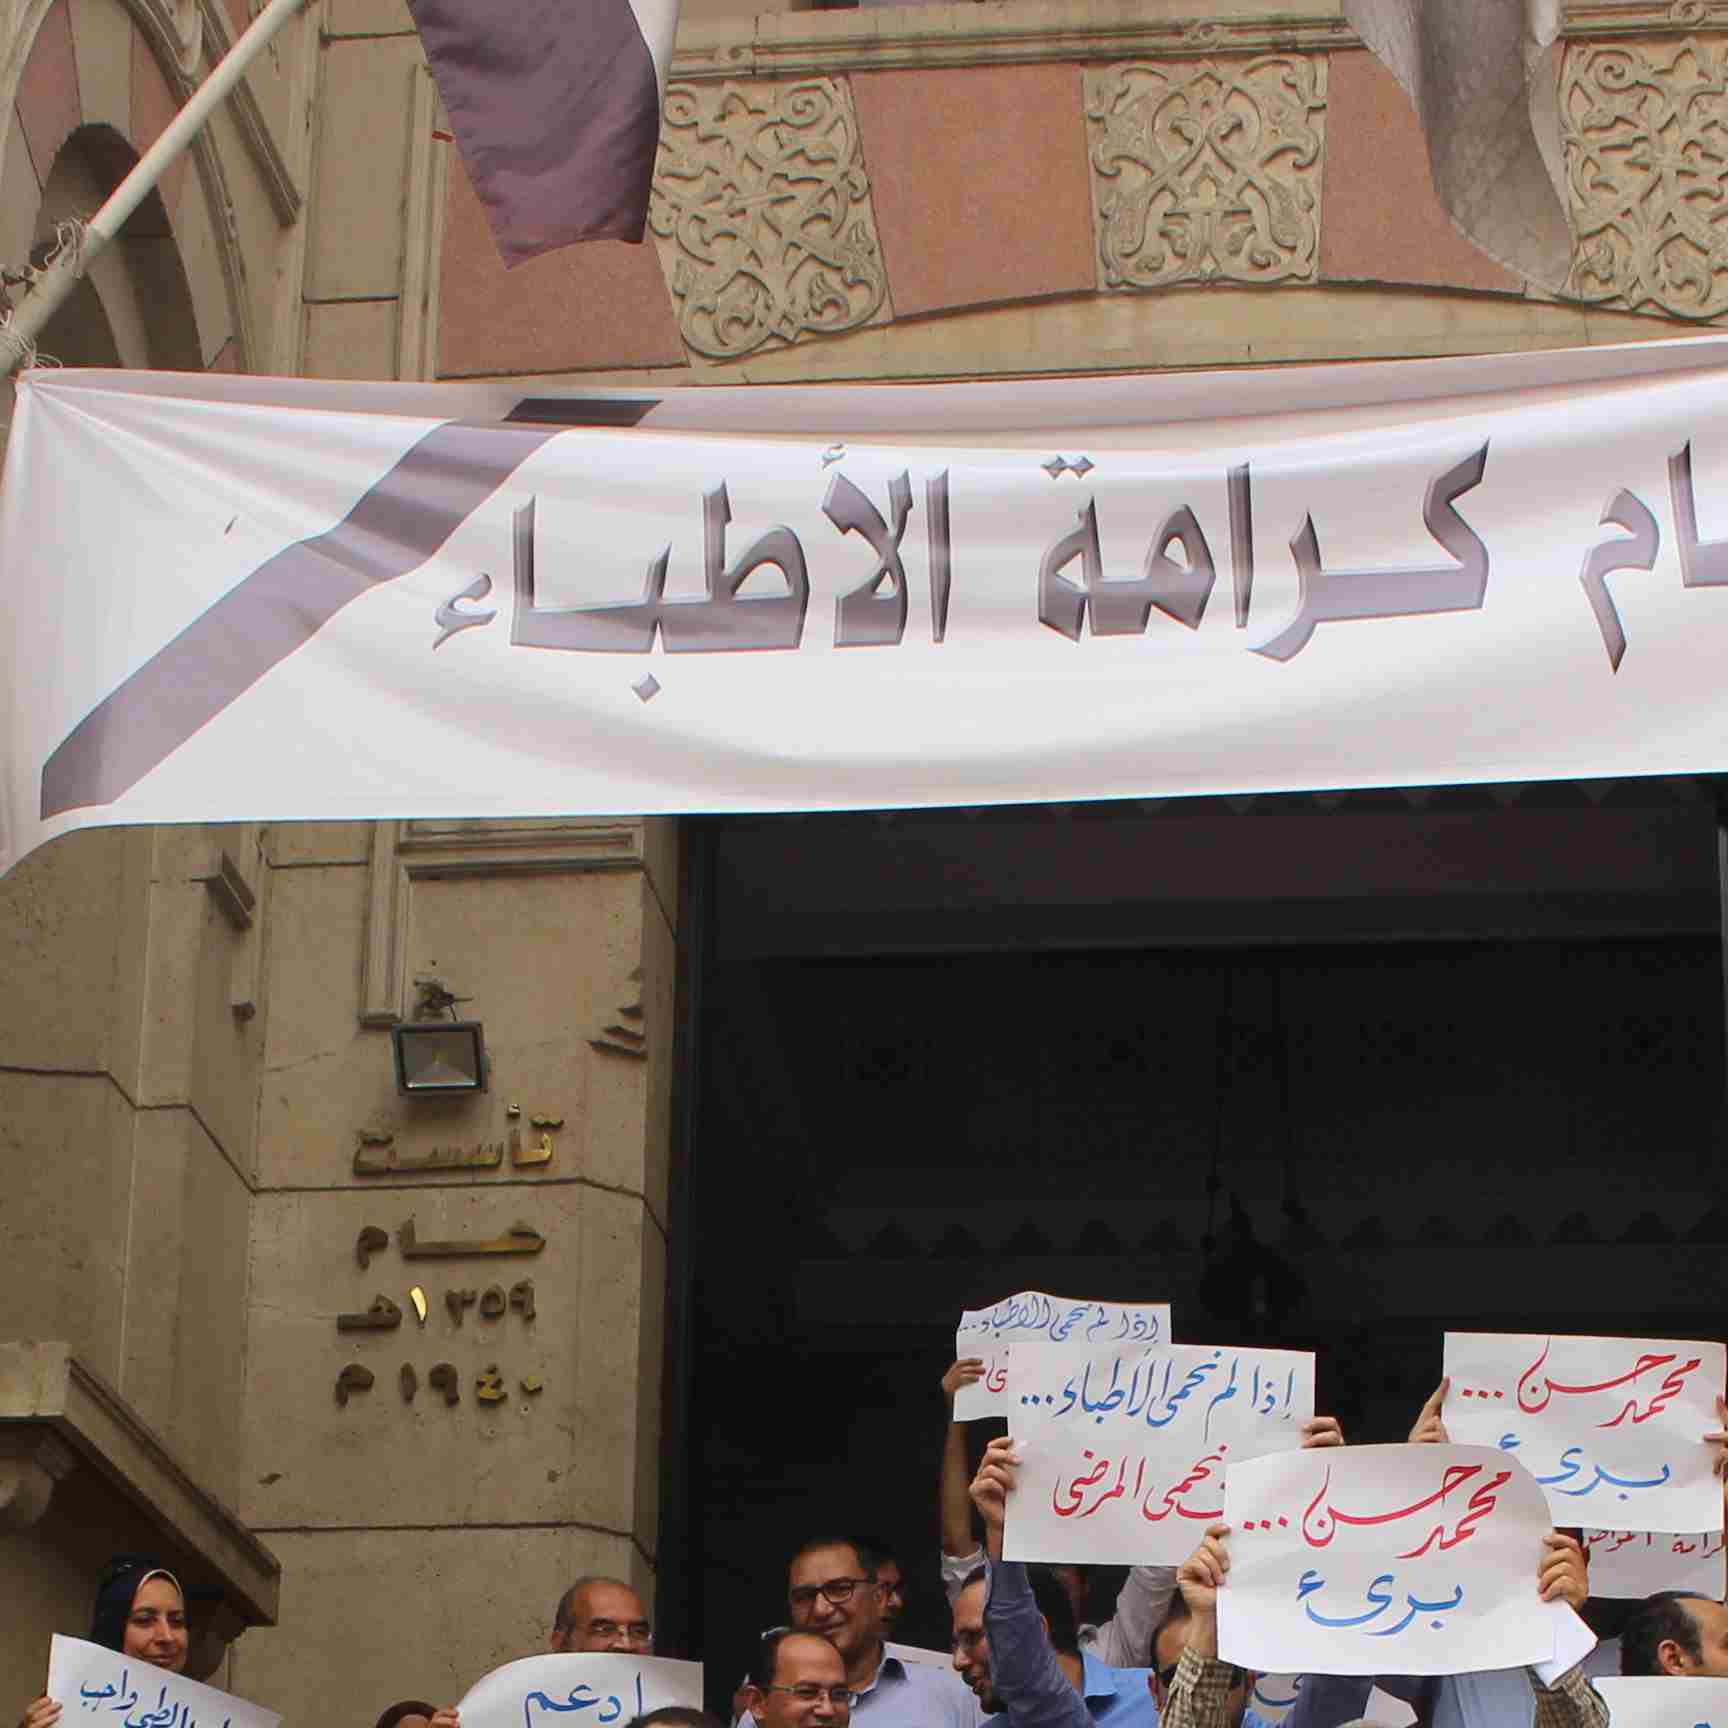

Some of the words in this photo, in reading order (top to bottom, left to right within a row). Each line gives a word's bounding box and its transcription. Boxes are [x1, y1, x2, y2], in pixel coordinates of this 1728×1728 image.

[431, 441, 954, 700] الأطباء
[1037, 441, 1491, 662] كرامة
[1204, 1358, 1238, 1444] لم
[1595, 1357, 1701, 1428] محمد
[1395, 1470, 1512, 1559] محمد
